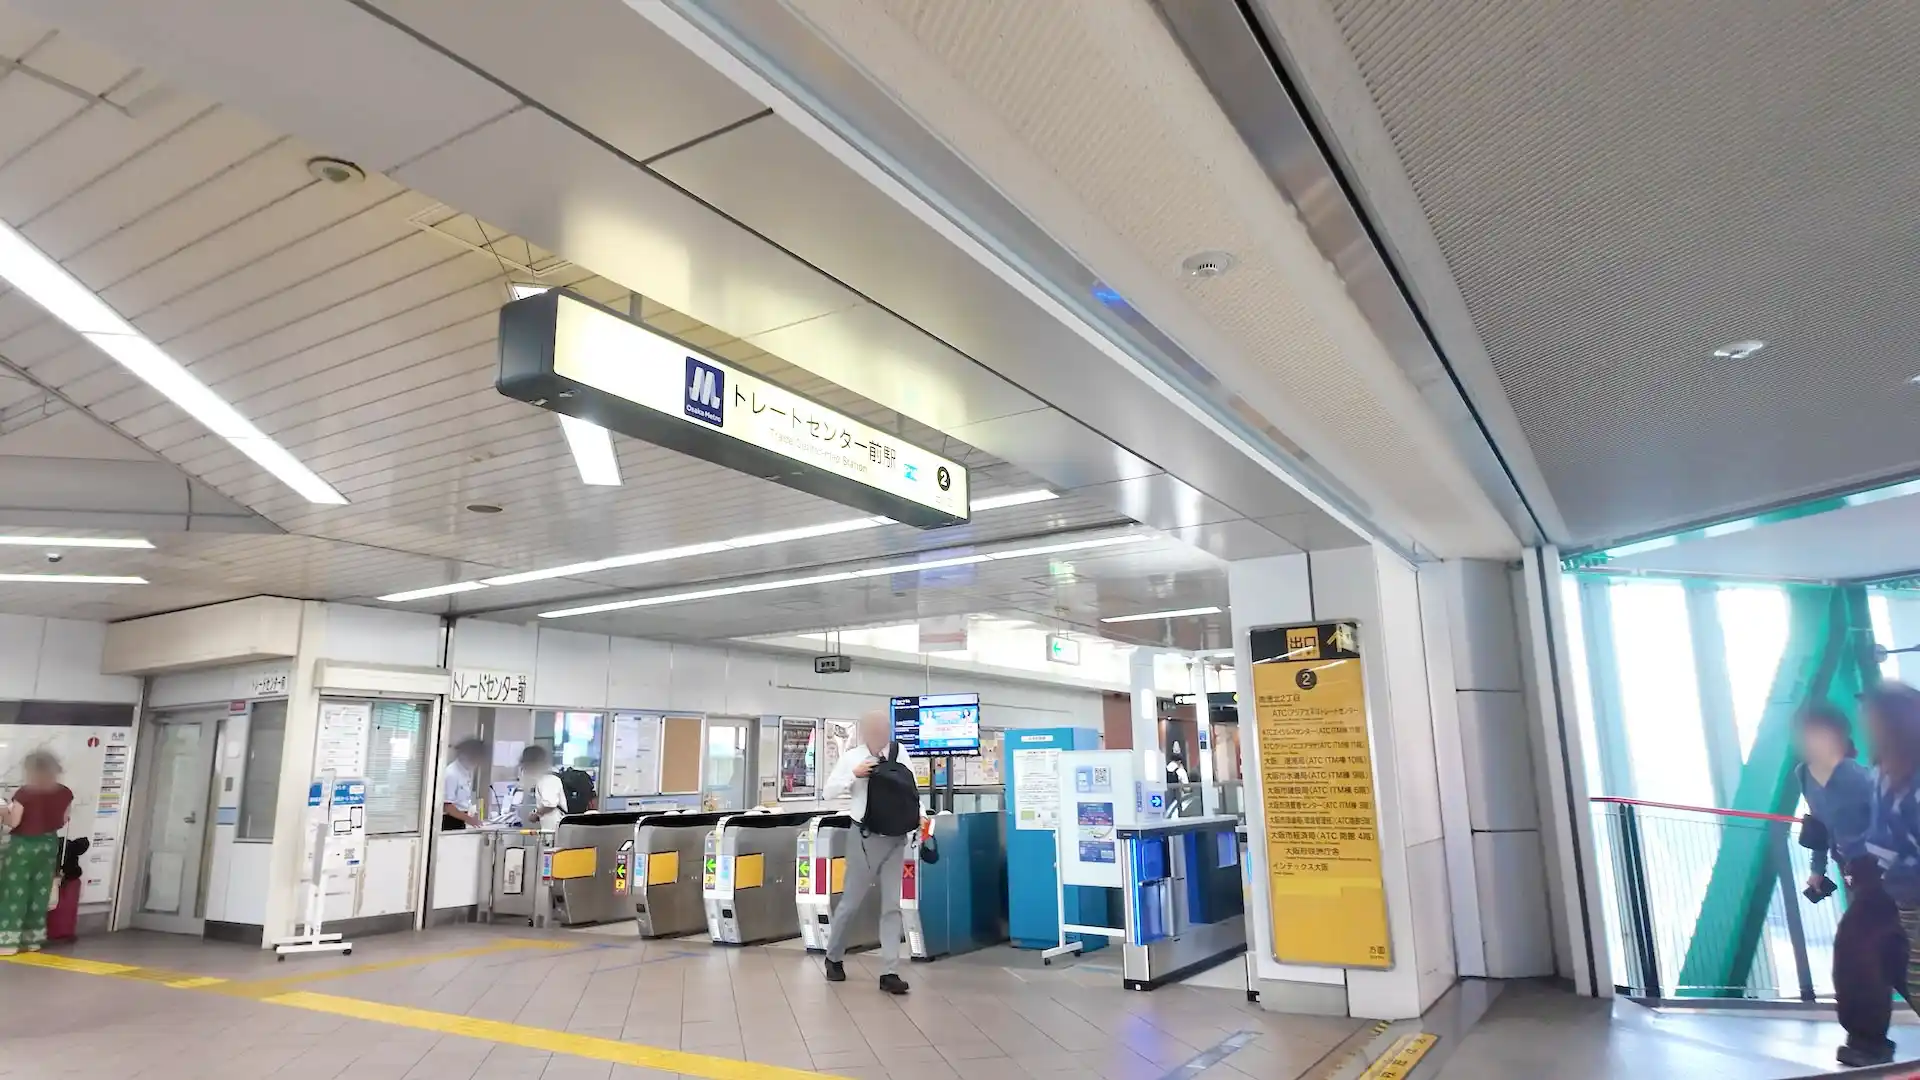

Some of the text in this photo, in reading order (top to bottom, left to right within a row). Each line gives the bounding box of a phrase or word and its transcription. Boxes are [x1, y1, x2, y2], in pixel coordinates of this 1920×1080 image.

[686, 404, 722, 423] Osaka Metro
[1290, 636, 1316, 649] 出口
[452, 671, 527, 704] トレードセンター前
[1272, 862, 1329, 872] インテックス大阪
